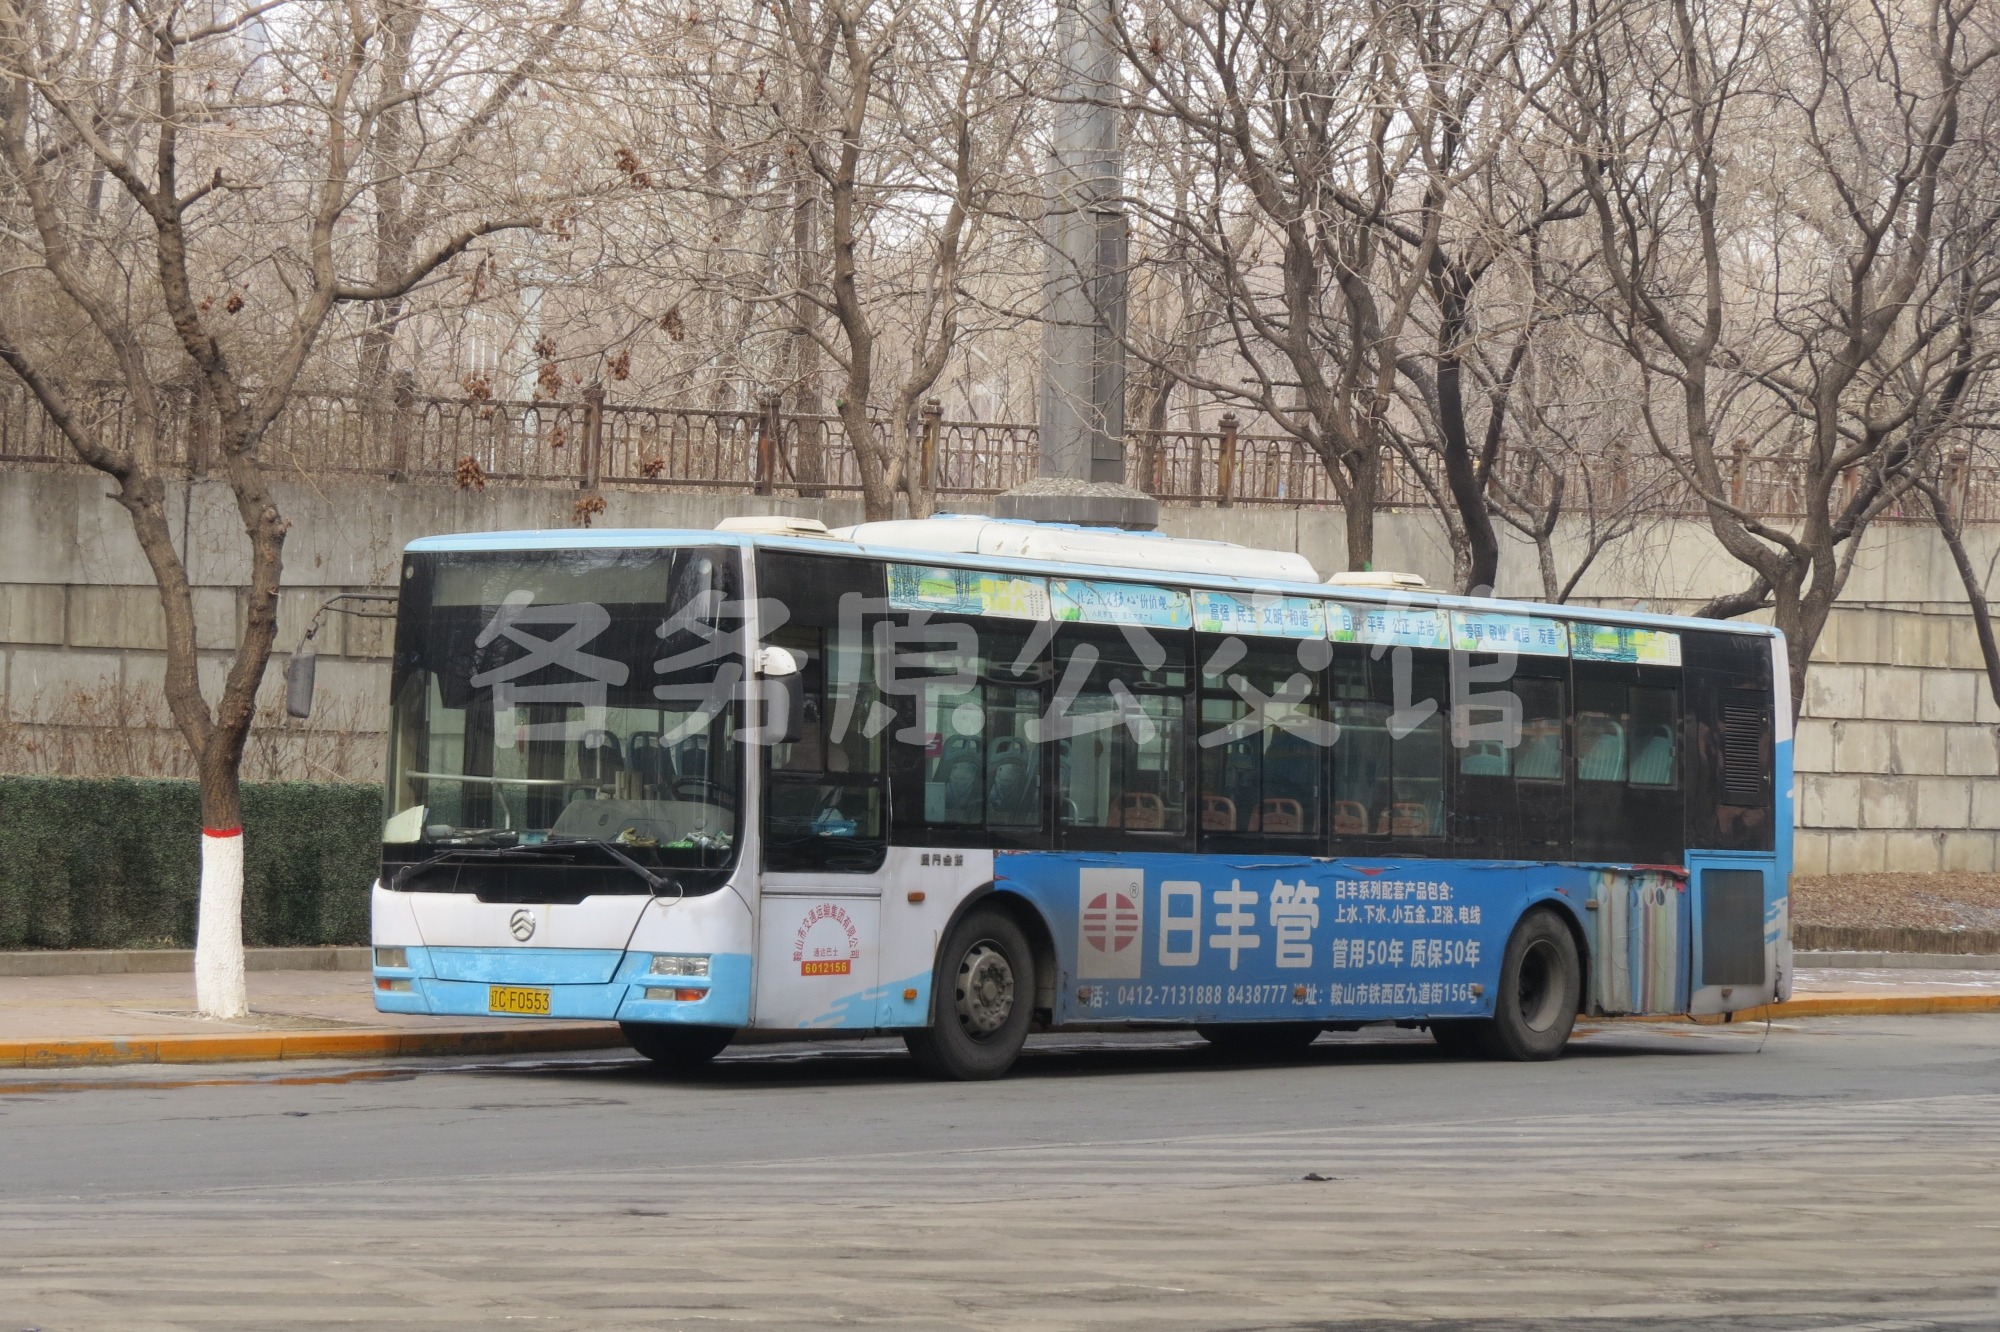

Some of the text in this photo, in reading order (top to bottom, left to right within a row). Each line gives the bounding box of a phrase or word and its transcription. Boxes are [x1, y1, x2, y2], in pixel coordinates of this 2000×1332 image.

[1210, 603, 1309, 627] 富强 民主 文明 和谐
[1342, 614, 1435, 636] 自由 平等 公正 法治
[1465, 623, 1556, 645] 爱国 敬业 诚信 友善
[1159, 879, 1320, 971] 日丰管
[1335, 904, 1481, 924] 上水、下水、小五金、卫浴、电线
[814, 947, 838, 957] 通达巴士
[1333, 938, 1481, 968] 管用50年 质保50年
[805, 962, 847, 974] 6012156
[1227, 984, 1288, 1005] 8438777
